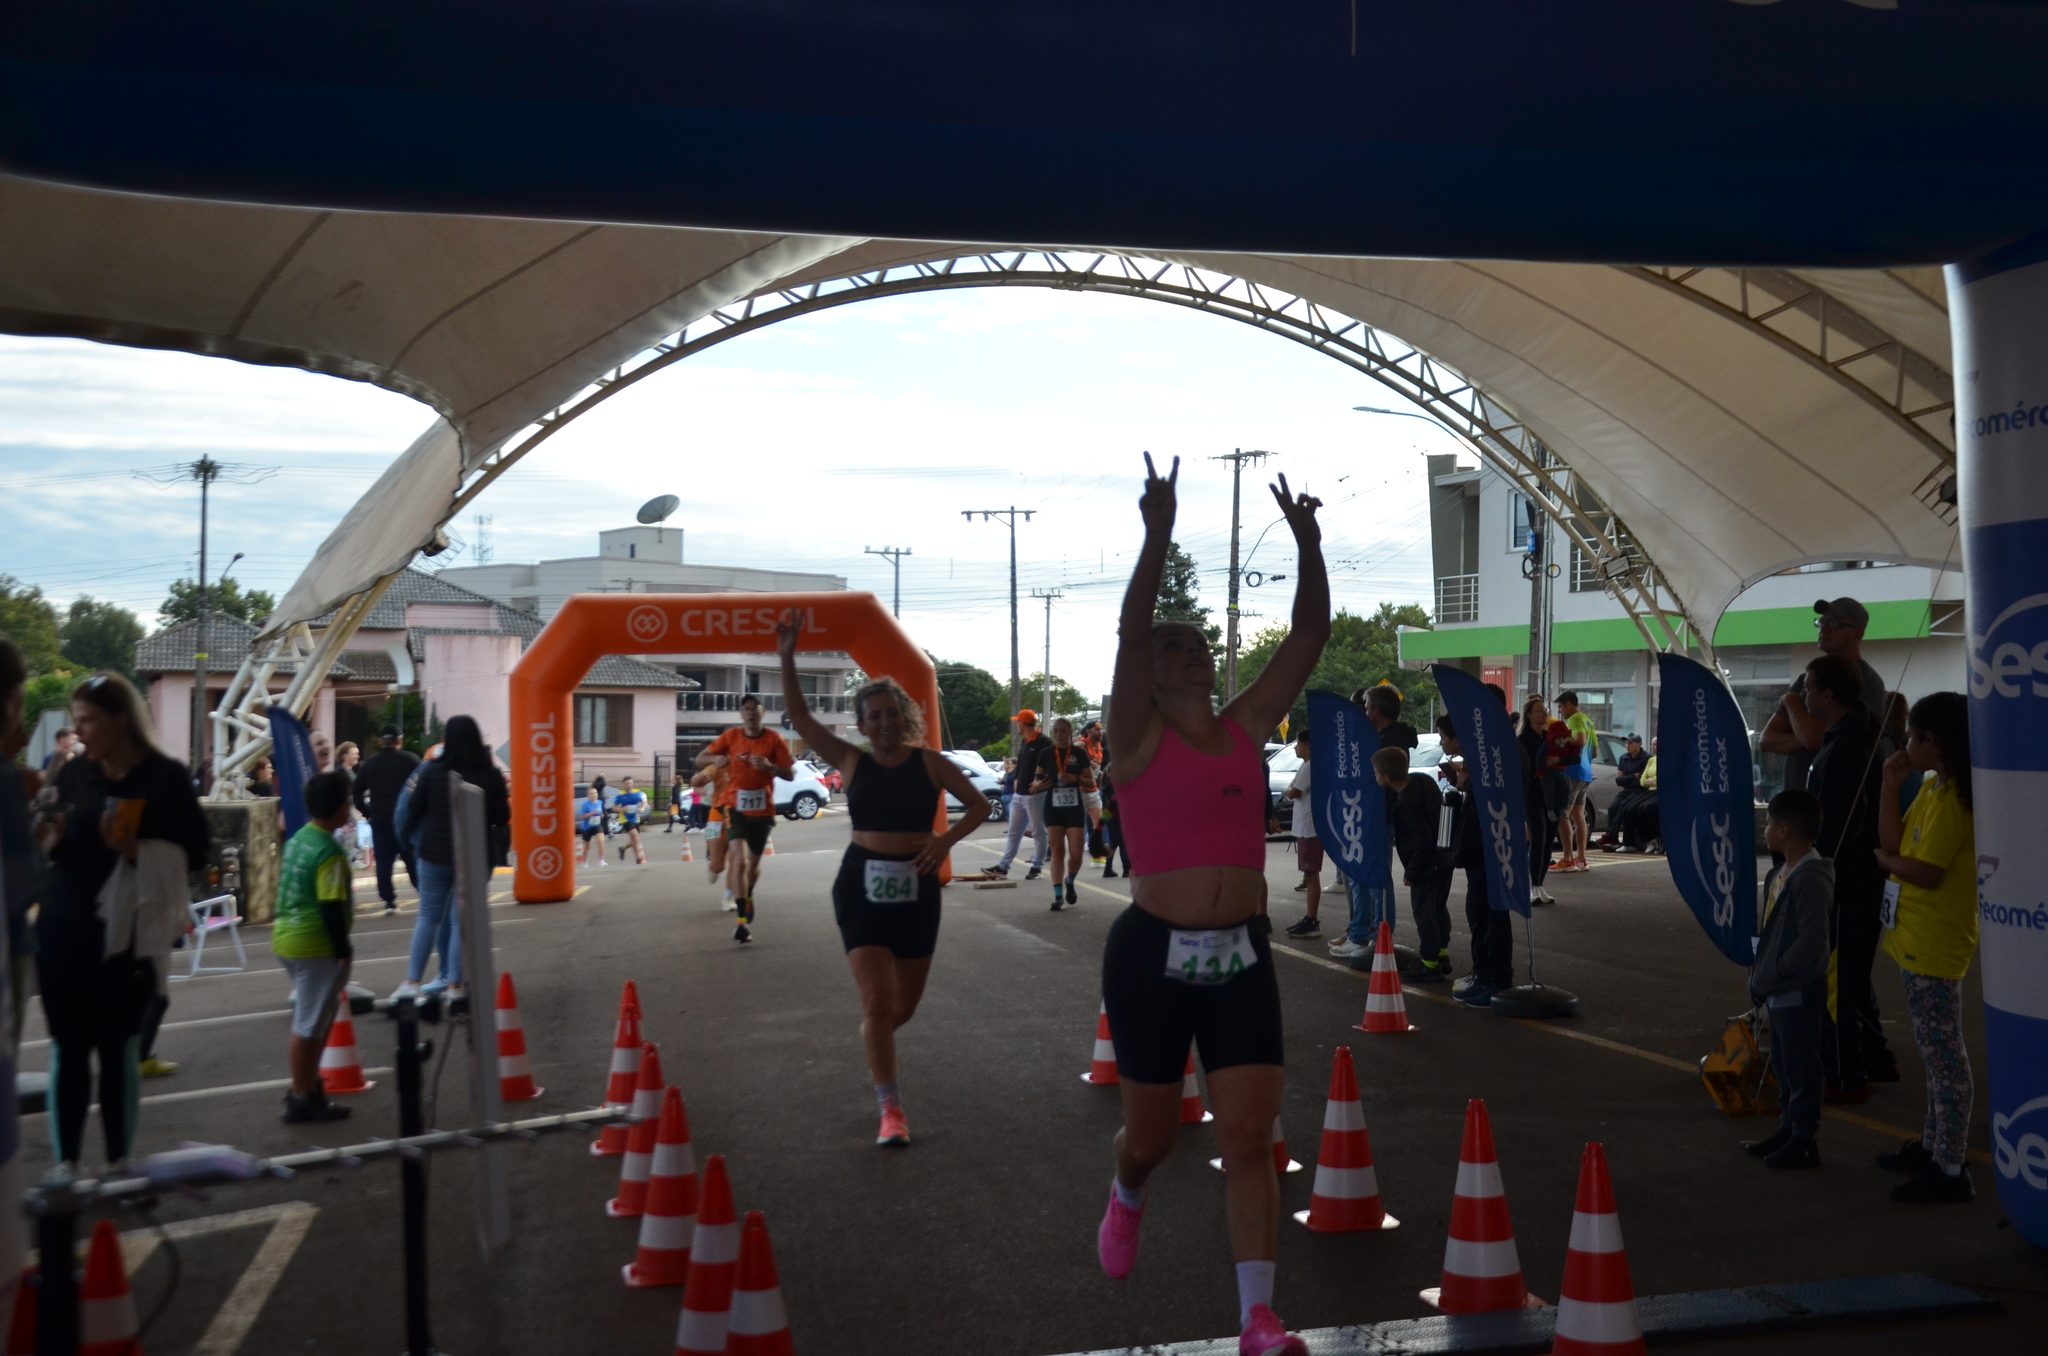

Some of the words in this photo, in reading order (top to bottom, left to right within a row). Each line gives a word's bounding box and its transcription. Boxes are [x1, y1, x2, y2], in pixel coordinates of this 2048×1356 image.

[680, 607, 827, 638] CRESOL
[1335, 710, 1347, 779] Fecomércio
[1472, 706, 1491, 788] Fecomércio
[1692, 687, 1714, 794] Fecomércio
[529, 712, 558, 836] CRESOL
[741, 796, 762, 809] 717
[1057, 794, 1076, 806] 132
[872, 875, 913, 899] 264
